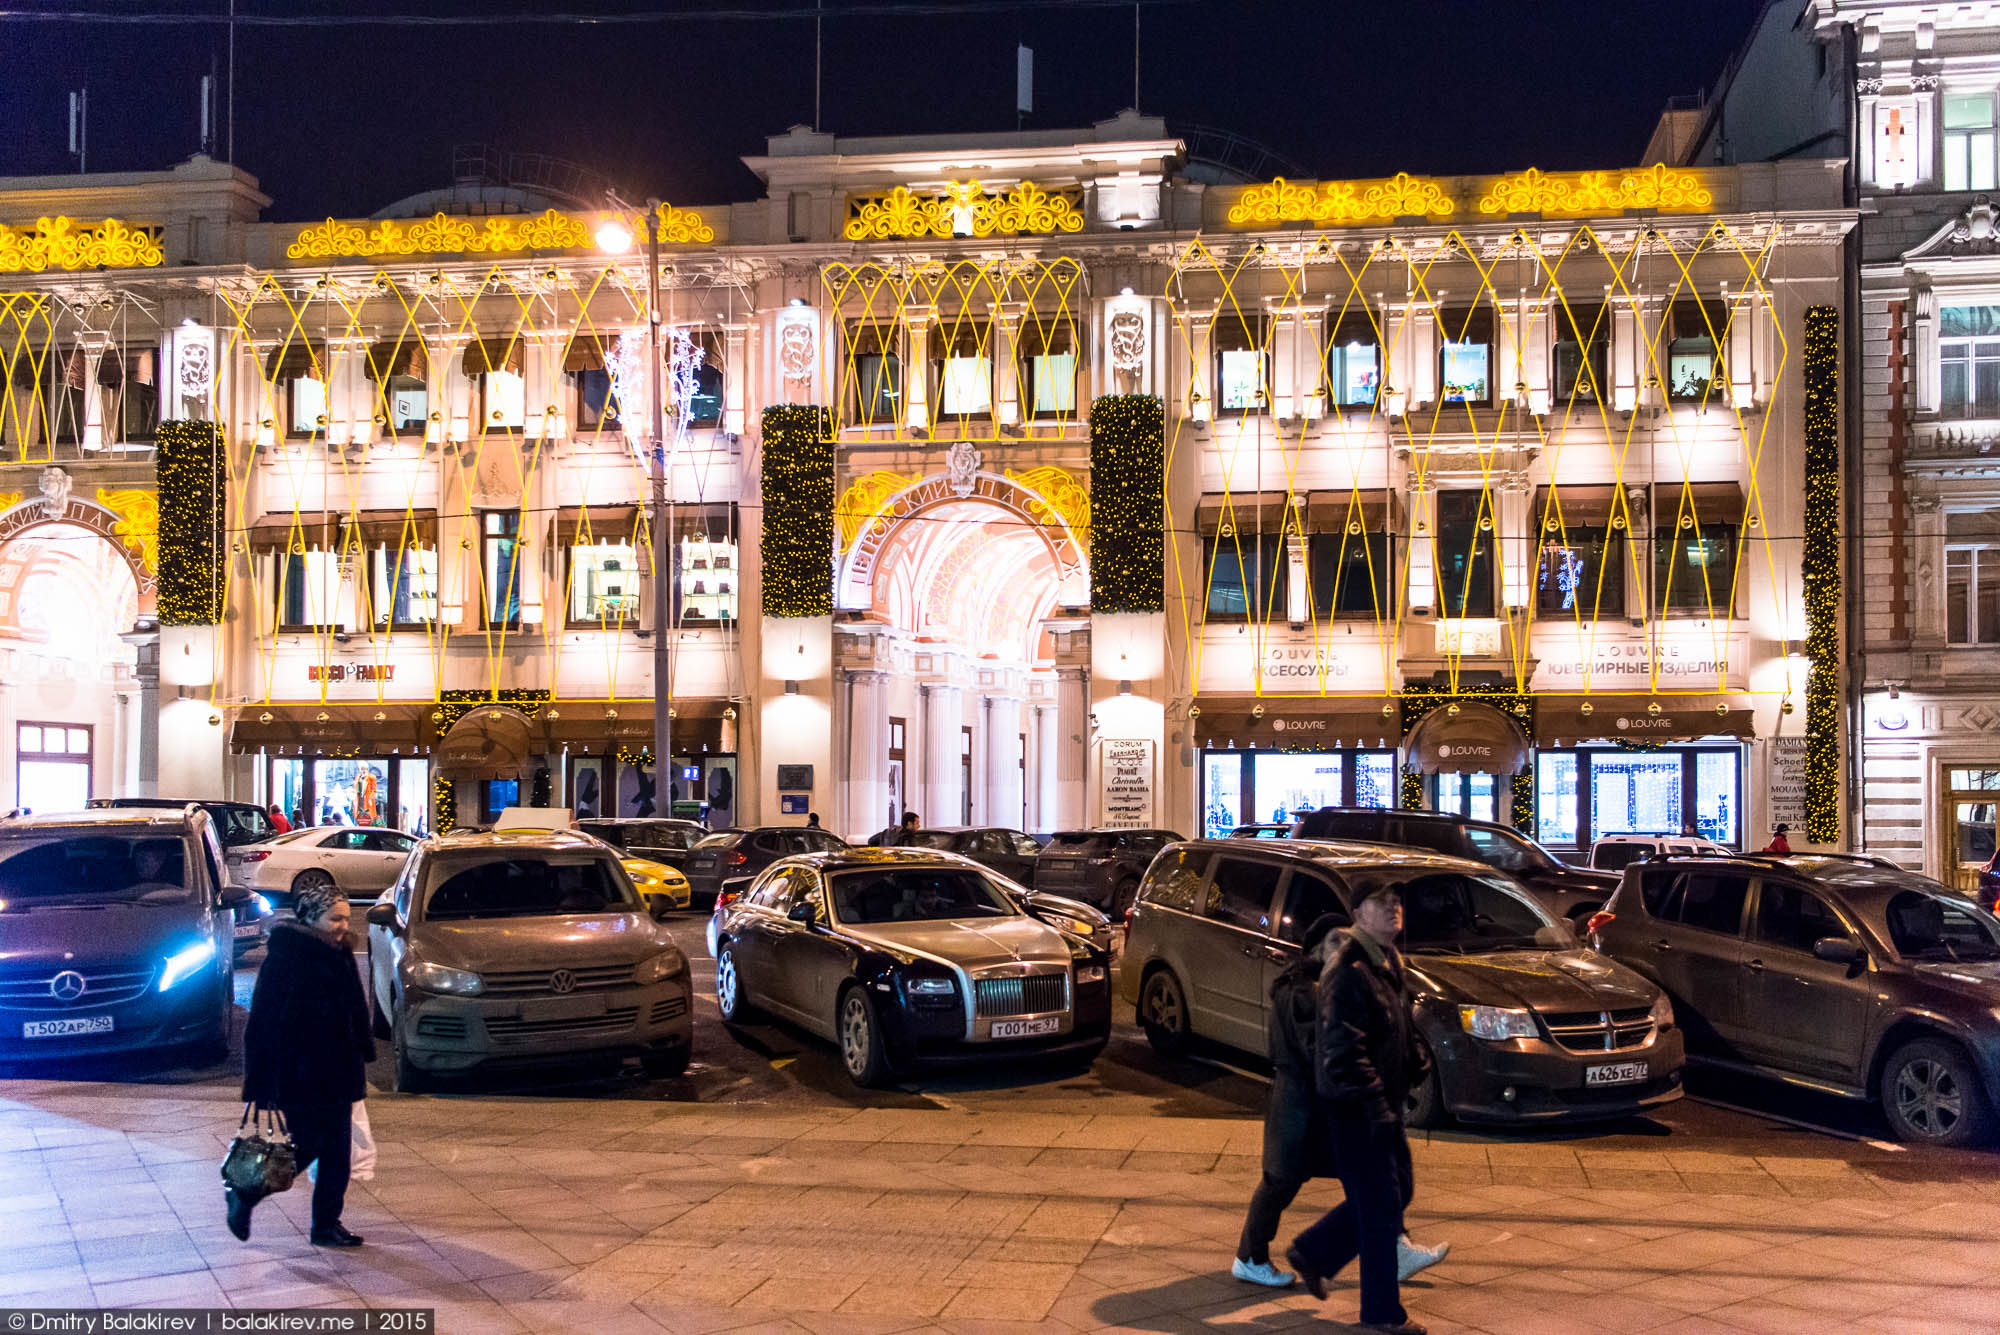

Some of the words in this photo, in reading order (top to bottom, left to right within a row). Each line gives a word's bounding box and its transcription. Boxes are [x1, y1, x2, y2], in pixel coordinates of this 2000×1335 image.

[851, 478, 950, 584] ПЕТРОВСКИЙ
[1597, 645, 1680, 657] LOUVRE
[1548, 662, 1650, 675] ЮВЕЛИРНЫЕ
[1654, 661, 1729, 676] ИЗДЕЛИЯ
[1286, 720, 1327, 730] LOUVRE
[1630, 718, 1672, 728] LOUVRE
[1451, 746, 1492, 756] LOUVRE
